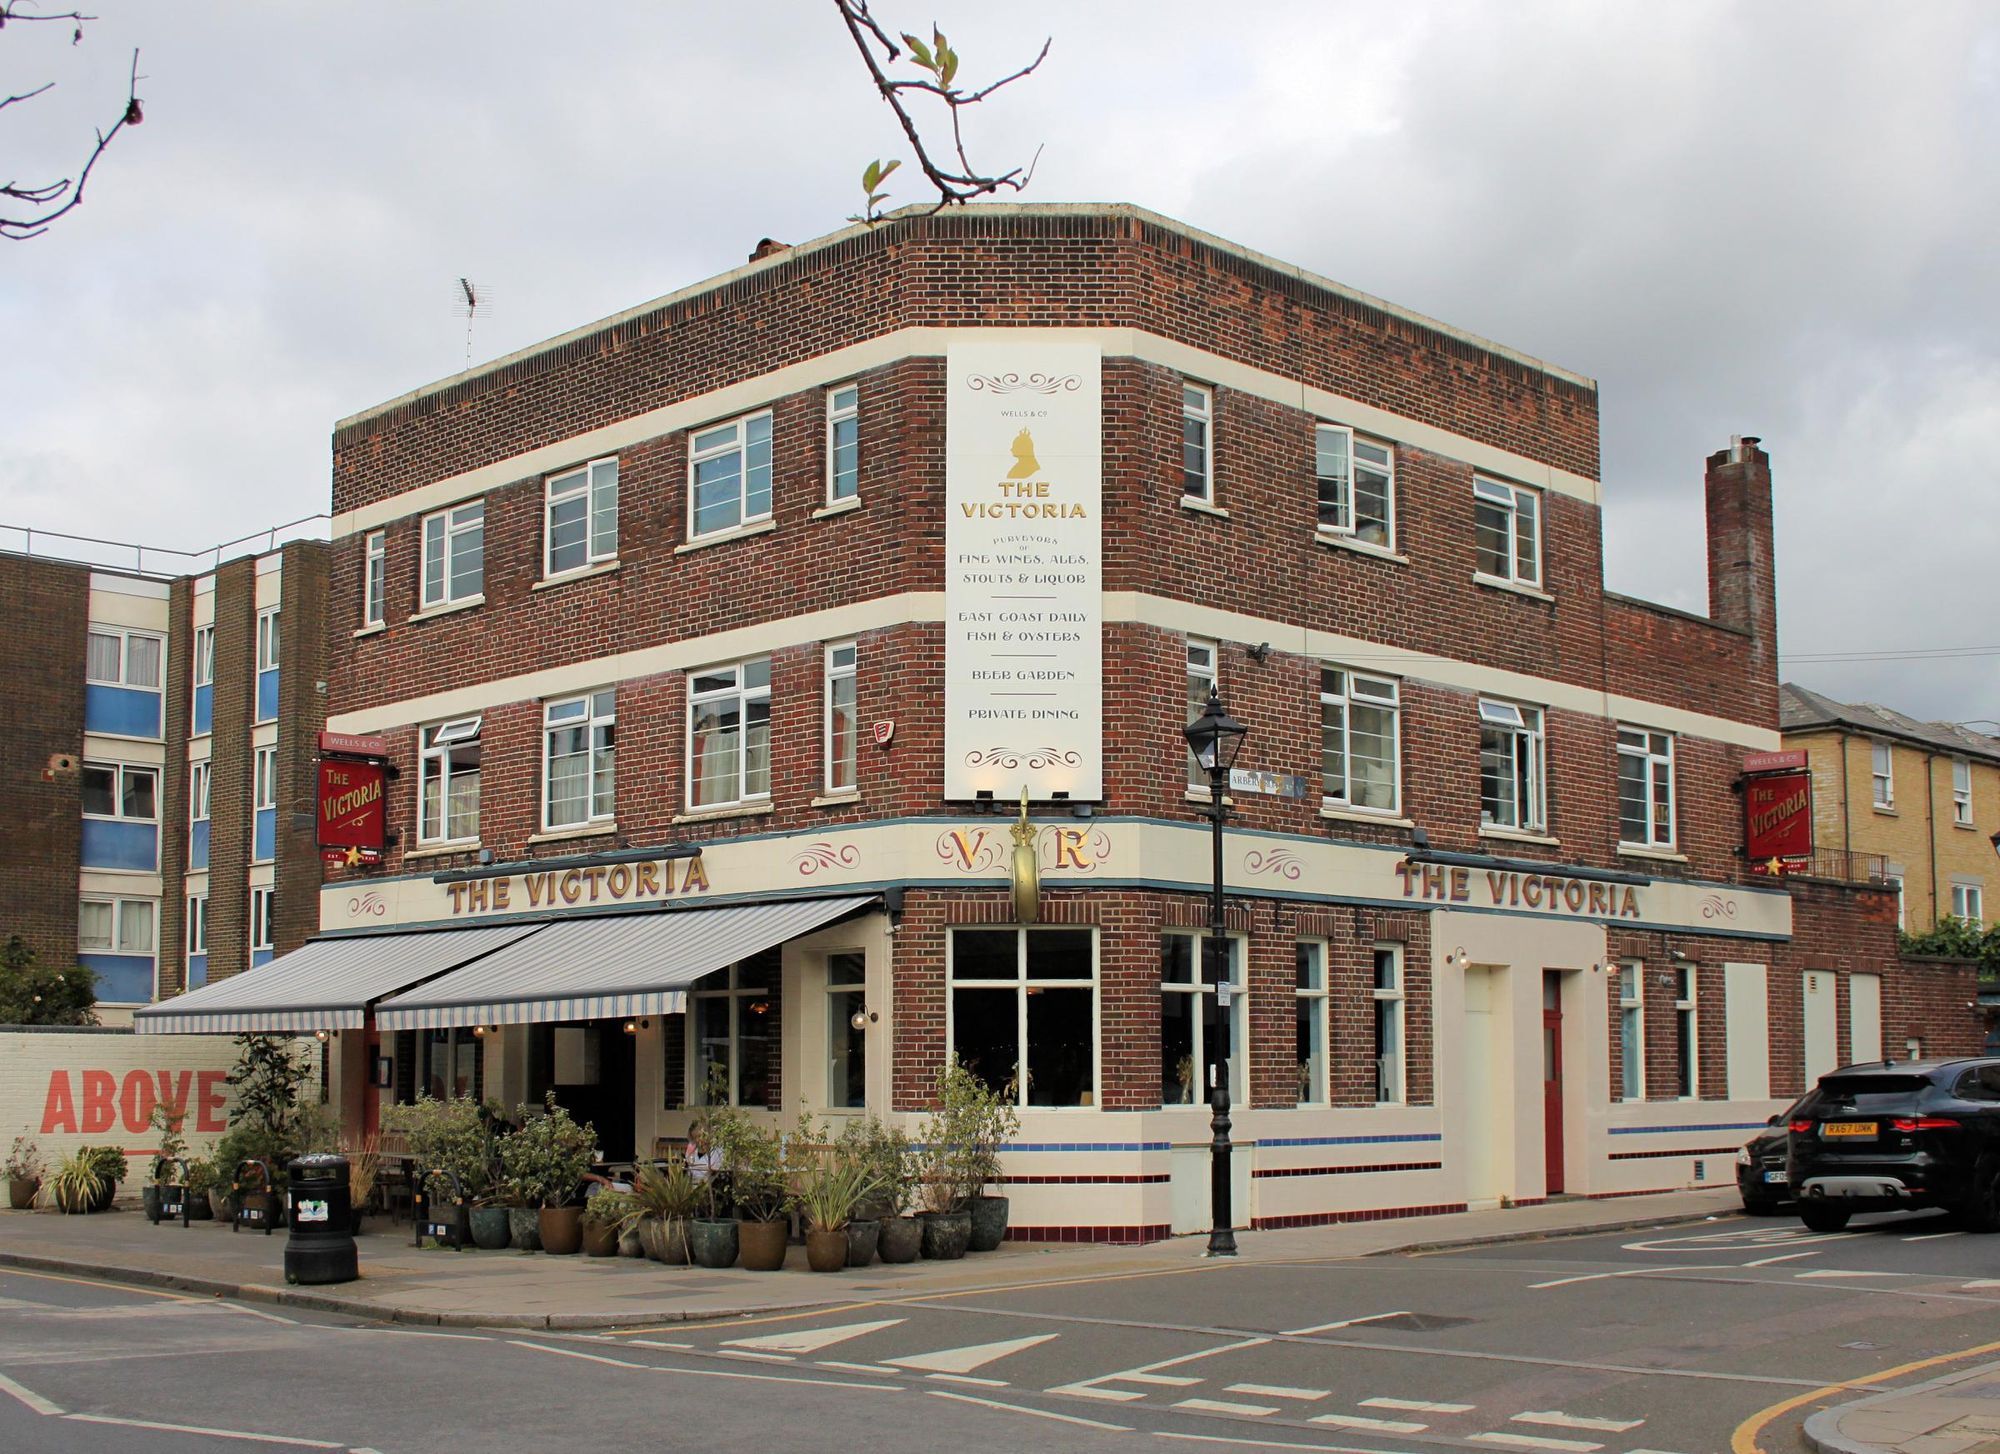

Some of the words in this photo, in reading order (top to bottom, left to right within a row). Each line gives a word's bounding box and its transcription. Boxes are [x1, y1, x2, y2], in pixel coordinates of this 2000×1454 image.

[998, 482, 1050, 498] THE
[960, 502, 1087, 519] VICTORIA
[993, 535, 1058, 545] PURVEYORS
[959, 554, 991, 564] FINE
[963, 573, 1013, 584] STOUTS
[1018, 573, 1029, 583] &
[1034, 574, 1086, 586] LIQUOR
[958, 612, 992, 622] EAST
[999, 612, 1044, 622] COAST
[1049, 612, 1088, 622] DAILY
[967, 631, 997, 641] FISH
[1002, 631, 1013, 641] &
[1018, 631, 1081, 641] OYSTERS
[972, 670, 1011, 680] BEER
[1017, 670, 1075, 680] GARDEN
[968, 709, 1027, 719] PRIVATE
[1032, 709, 1079, 719] DINING
[330, 736, 360, 748] WELLS
[361, 740, 368, 748] &
[1749, 756, 1778, 766] WELLS
[950, 828, 990, 870] V
[1054, 829, 1093, 869] R
[447, 876, 511, 914] THE
[525, 856, 709, 907] VICTORIA
[1395, 860, 1471, 901] THE
[1486, 870, 1641, 918] VICTORIA
[40, 1069, 227, 1134] ABOVE
